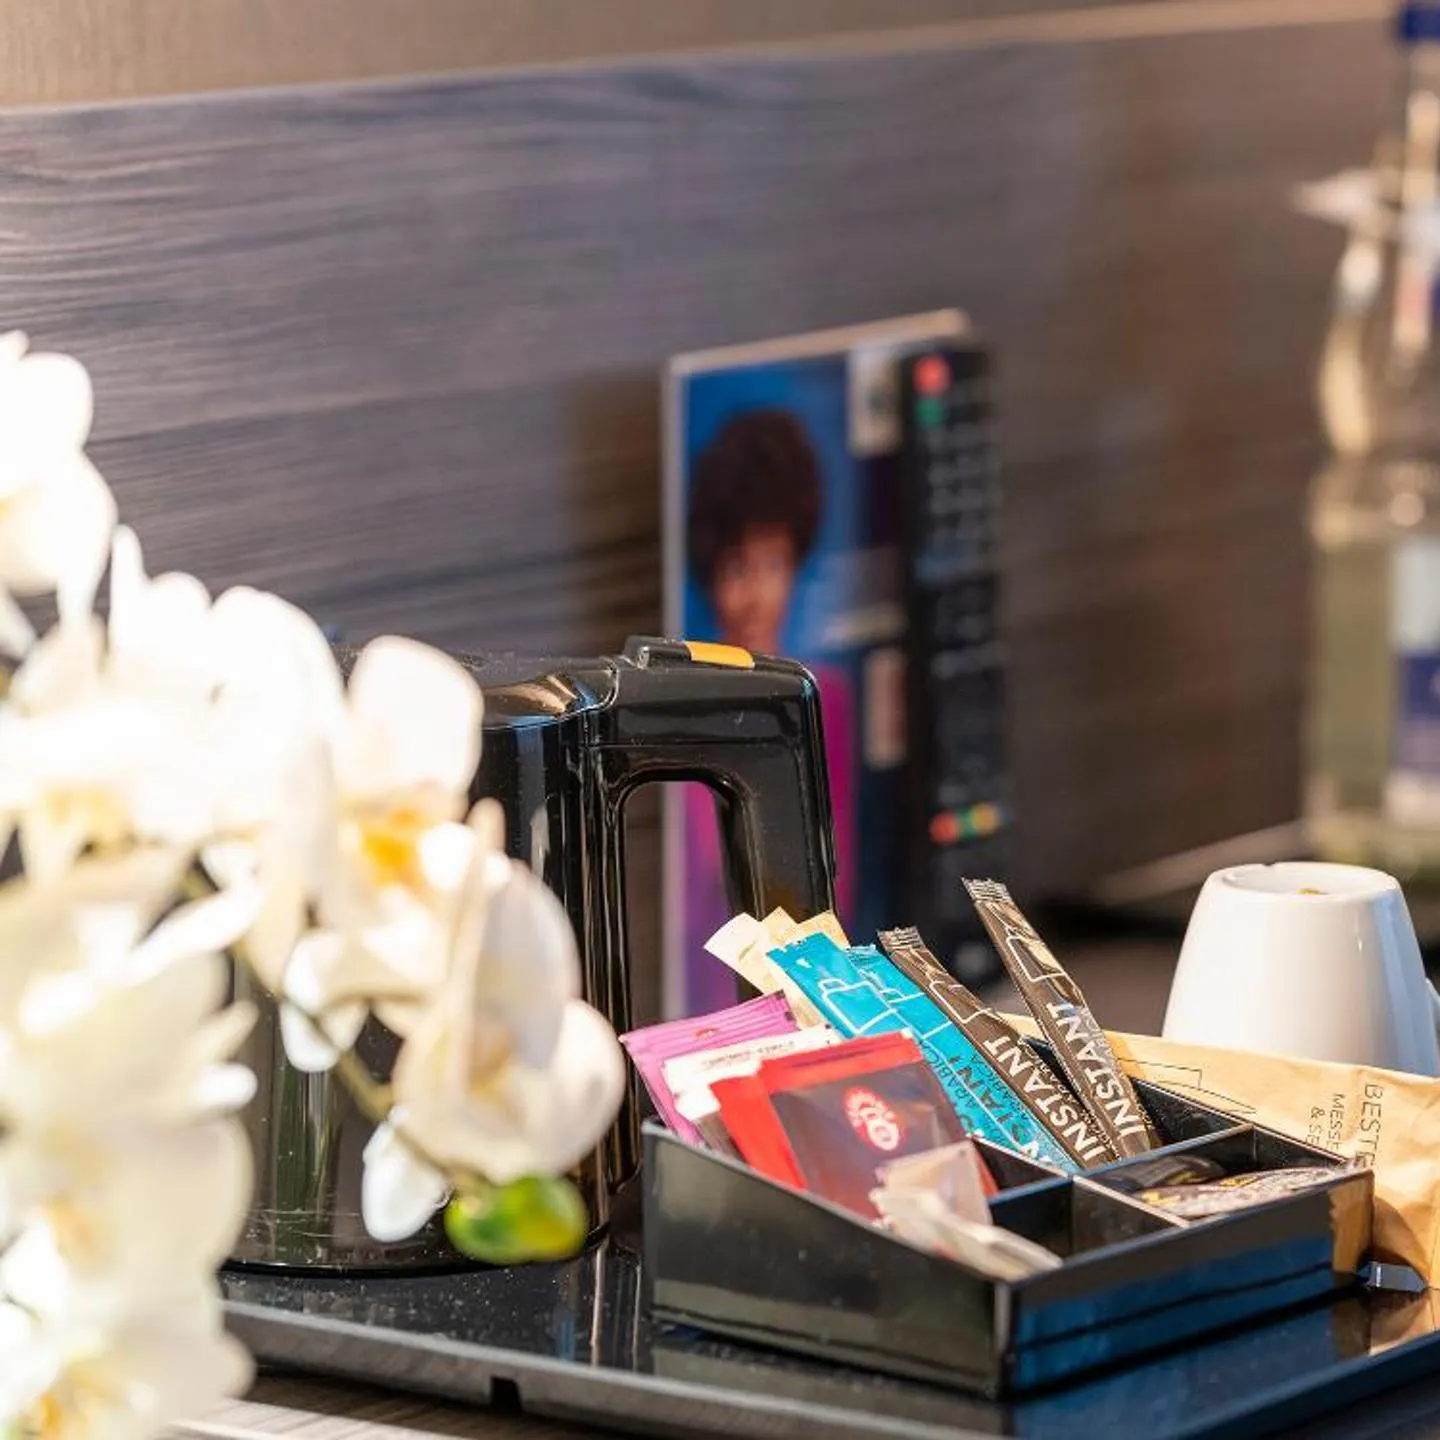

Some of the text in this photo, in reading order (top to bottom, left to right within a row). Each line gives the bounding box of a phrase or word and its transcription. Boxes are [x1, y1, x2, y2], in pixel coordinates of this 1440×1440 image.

[948, 1055, 1050, 1161] NSTANT
[984, 1036, 1107, 1161] INSTANT
[1046, 1002, 1146, 1140] INSTANT
